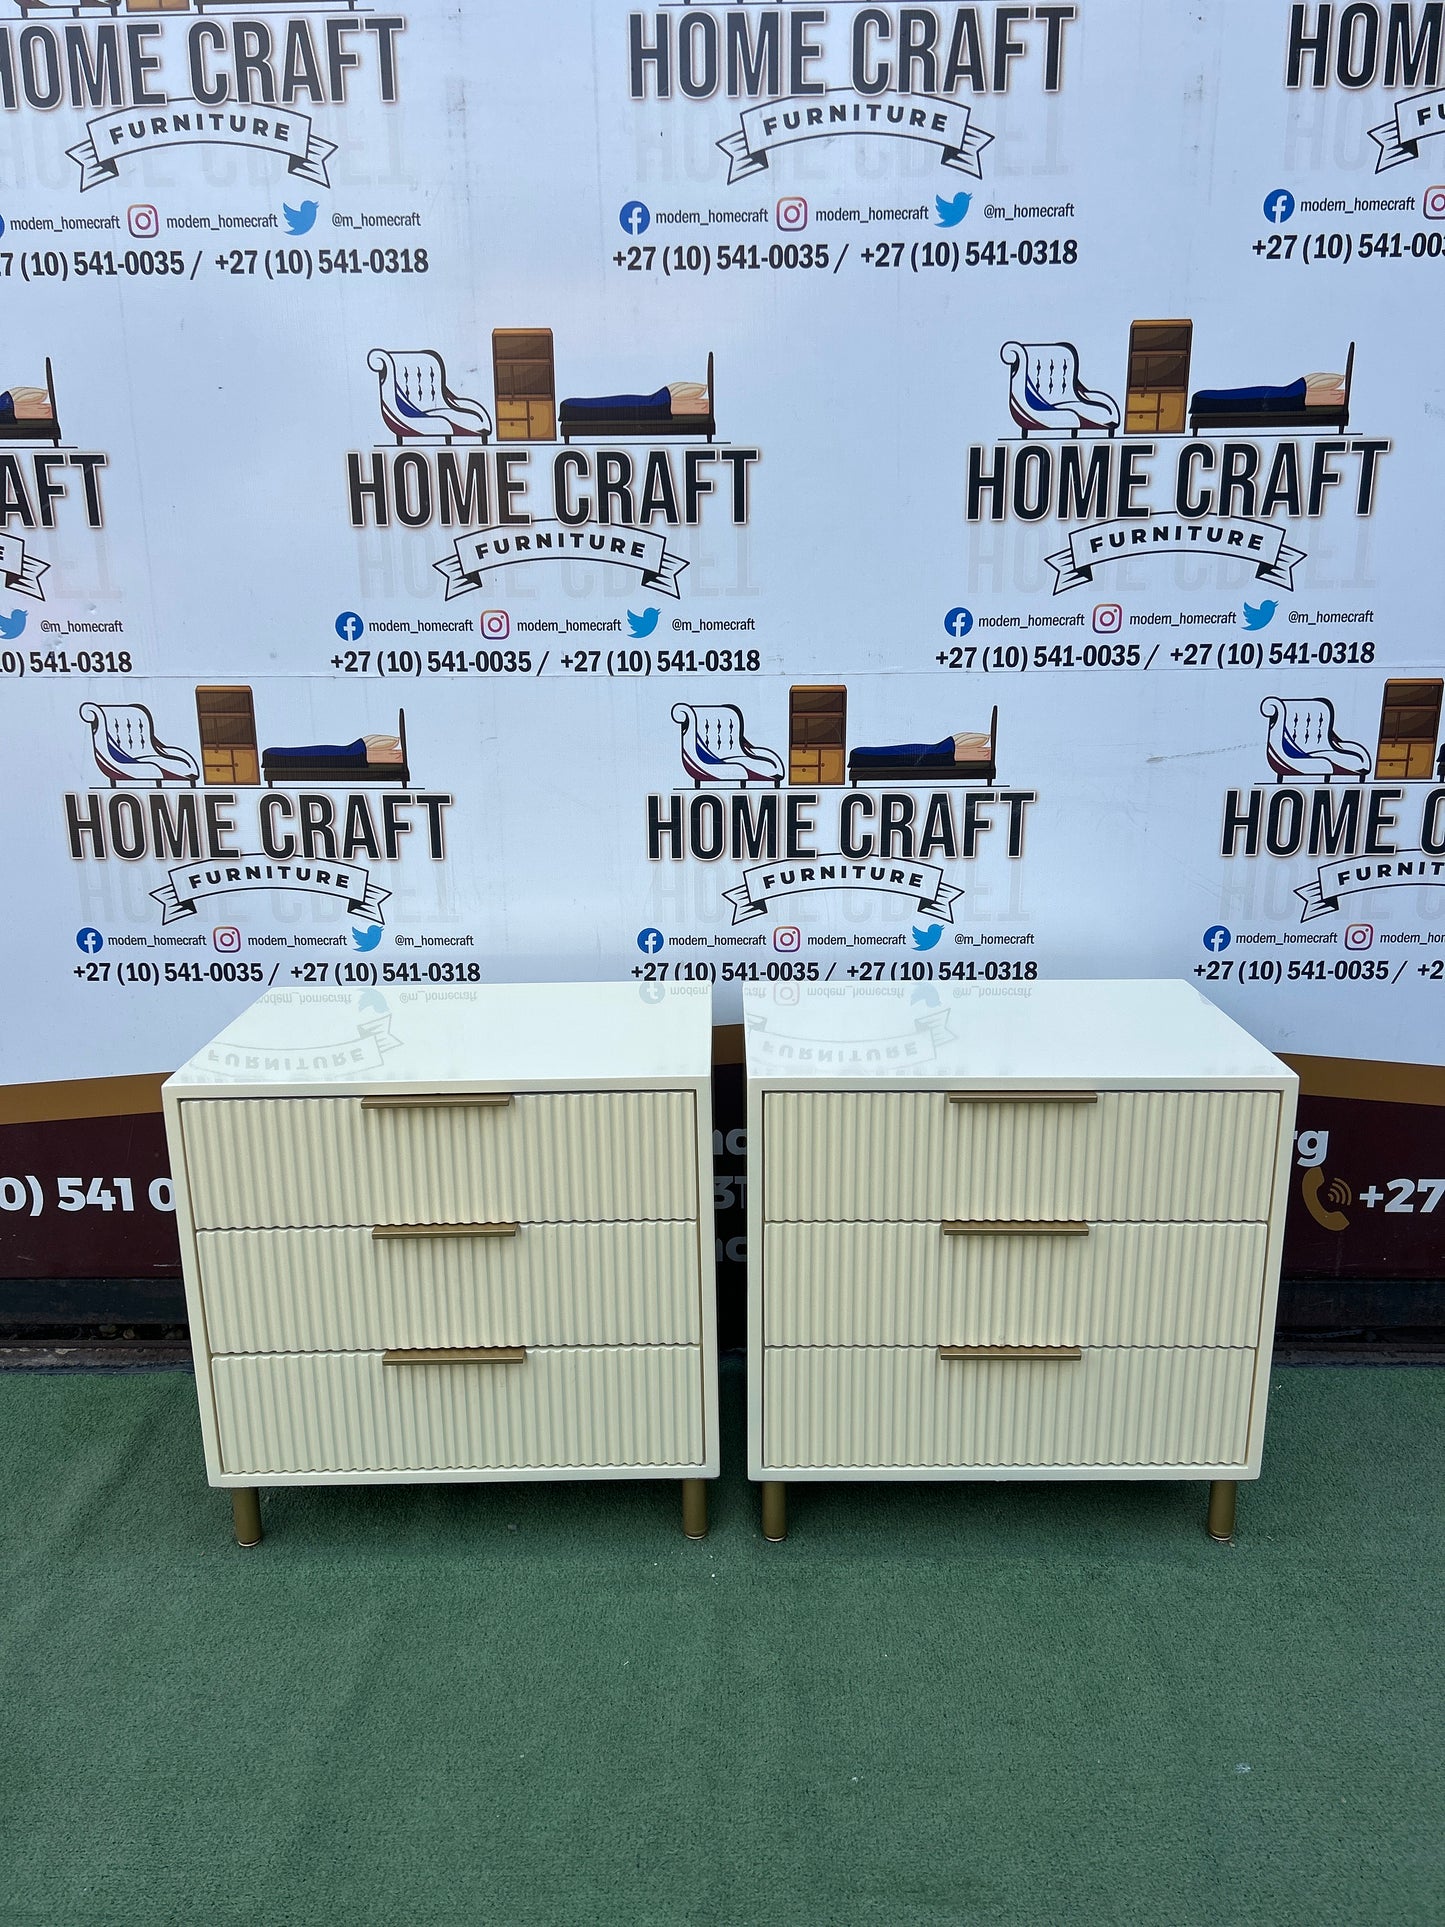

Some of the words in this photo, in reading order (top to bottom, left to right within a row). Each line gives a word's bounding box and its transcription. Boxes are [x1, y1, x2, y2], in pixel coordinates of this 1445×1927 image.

[187, 16, 406, 107] CRAFT
[628, 8, 828, 99] HOME
[851, 5, 1077, 96] CRAFT
[109, 112, 291, 145] FURNITURE
[763, 103, 948, 136] FURNITURE
[331, 211, 422, 230] @m_homecraft
[983, 202, 1075, 221] @m_homecraft
[612, 246, 657, 270] +27
[662, 245, 711, 276] (10)
[716, 244, 830, 270] 541-0035
[860, 242, 906, 267] +27
[911, 242, 960, 272] (10)
[964, 239, 1078, 266] 541-0318
[1252, 234, 1298, 260] +27
[1302, 234, 1353, 265] (10)
[1357, 232, 1445, 259] 541-00
[21, 252, 69, 282] (10)
[74, 250, 185, 276] 541-0035
[214, 250, 258, 275] +27
[264, 249, 313, 280] (10)
[318, 248, 429, 274] 541-0318
[346, 450, 532, 528] HOME
[552, 448, 759, 526] CRAFT
[965, 442, 1156, 521] HOME
[1175, 439, 1391, 520] CRAFT
[475, 532, 646, 560] FURNITURE
[1089, 525, 1265, 554] FURNITURE
[41, 620, 124, 634] @m_homecraft
[671, 617, 756, 634] @m_homecraft
[1288, 609, 1375, 626] @m_homecraft
[29, 651, 133, 673] 541-0318
[329, 651, 371, 673] +27
[376, 650, 423, 677] (10)
[427, 650, 531, 672] 541-0035
[560, 651, 602, 672] +27
[606, 650, 652, 677] (10)
[656, 649, 760, 672] 541-0318
[935, 646, 978, 669] +27
[982, 645, 1028, 672] (10)
[1033, 643, 1141, 668] 541-0035
[1169, 643, 1214, 667] +27
[1217, 642, 1264, 669] (10)
[1268, 641, 1376, 665] 541-0318
[64, 792, 242, 861] HOME
[258, 792, 453, 860] CRAFT
[646, 793, 818, 861] HOME
[838, 791, 1036, 860] CRAFT
[1220, 787, 1403, 857] HOME
[189, 865, 351, 889] FURNITURE
[763, 865, 924, 889] FURNITURE
[394, 935, 475, 949] @m_homecraft
[954, 933, 1035, 947] @m_homecraft
[74, 963, 111, 982] +27
[116, 963, 160, 986] (10)
[164, 963, 264, 982] 541-0035
[290, 963, 329, 982] +27
[334, 963, 378, 986] (10)
[382, 962, 481, 982] 541-0318
[631, 963, 669, 981] +27
[674, 962, 717, 981] (10)
[721, 962, 820, 981] 541-0035
[846, 962, 886, 981] +27
[890, 962, 934, 981] (10)
[937, 961, 1038, 981] 541-0318
[1193, 961, 1234, 980] +27
[1238, 961, 1283, 985] (10)
[1287, 960, 1389, 980] 541-0035
[57, 1177, 135, 1212] 541
[1359, 1178, 1445, 1213] +27
